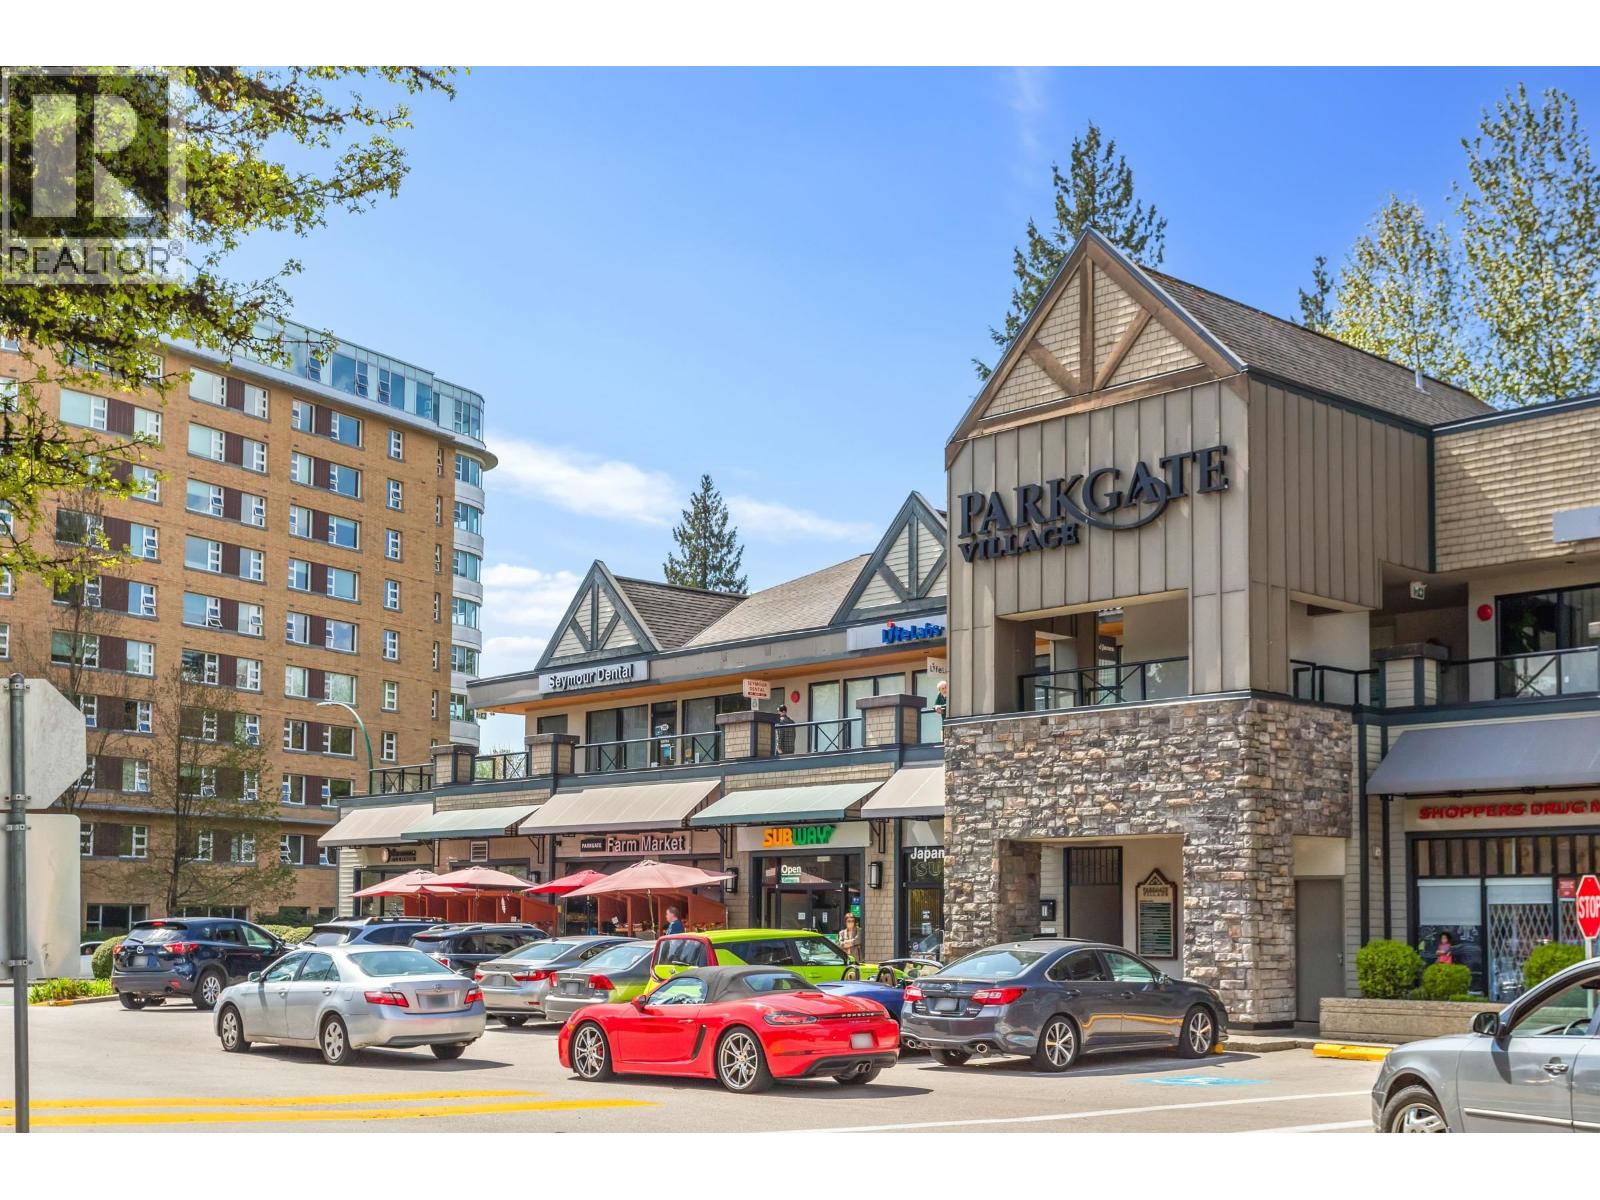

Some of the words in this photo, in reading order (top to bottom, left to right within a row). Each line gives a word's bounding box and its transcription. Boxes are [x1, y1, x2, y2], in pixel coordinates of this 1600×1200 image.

[958, 445, 1230, 539] PARKGATE
[958, 522, 1080, 563] VILLAGE
[549, 672, 596, 689] Seymour
[597, 664, 634, 682] Dental
[1419, 803, 1527, 820] SHOPPERS
[1530, 800, 1587, 816] DRUG
[607, 837, 639, 852] Farm
[641, 835, 686, 851] Market
[763, 825, 836, 848] SUBWAY
[781, 864, 801, 876] Open
[1579, 895, 1600, 919] STOP
